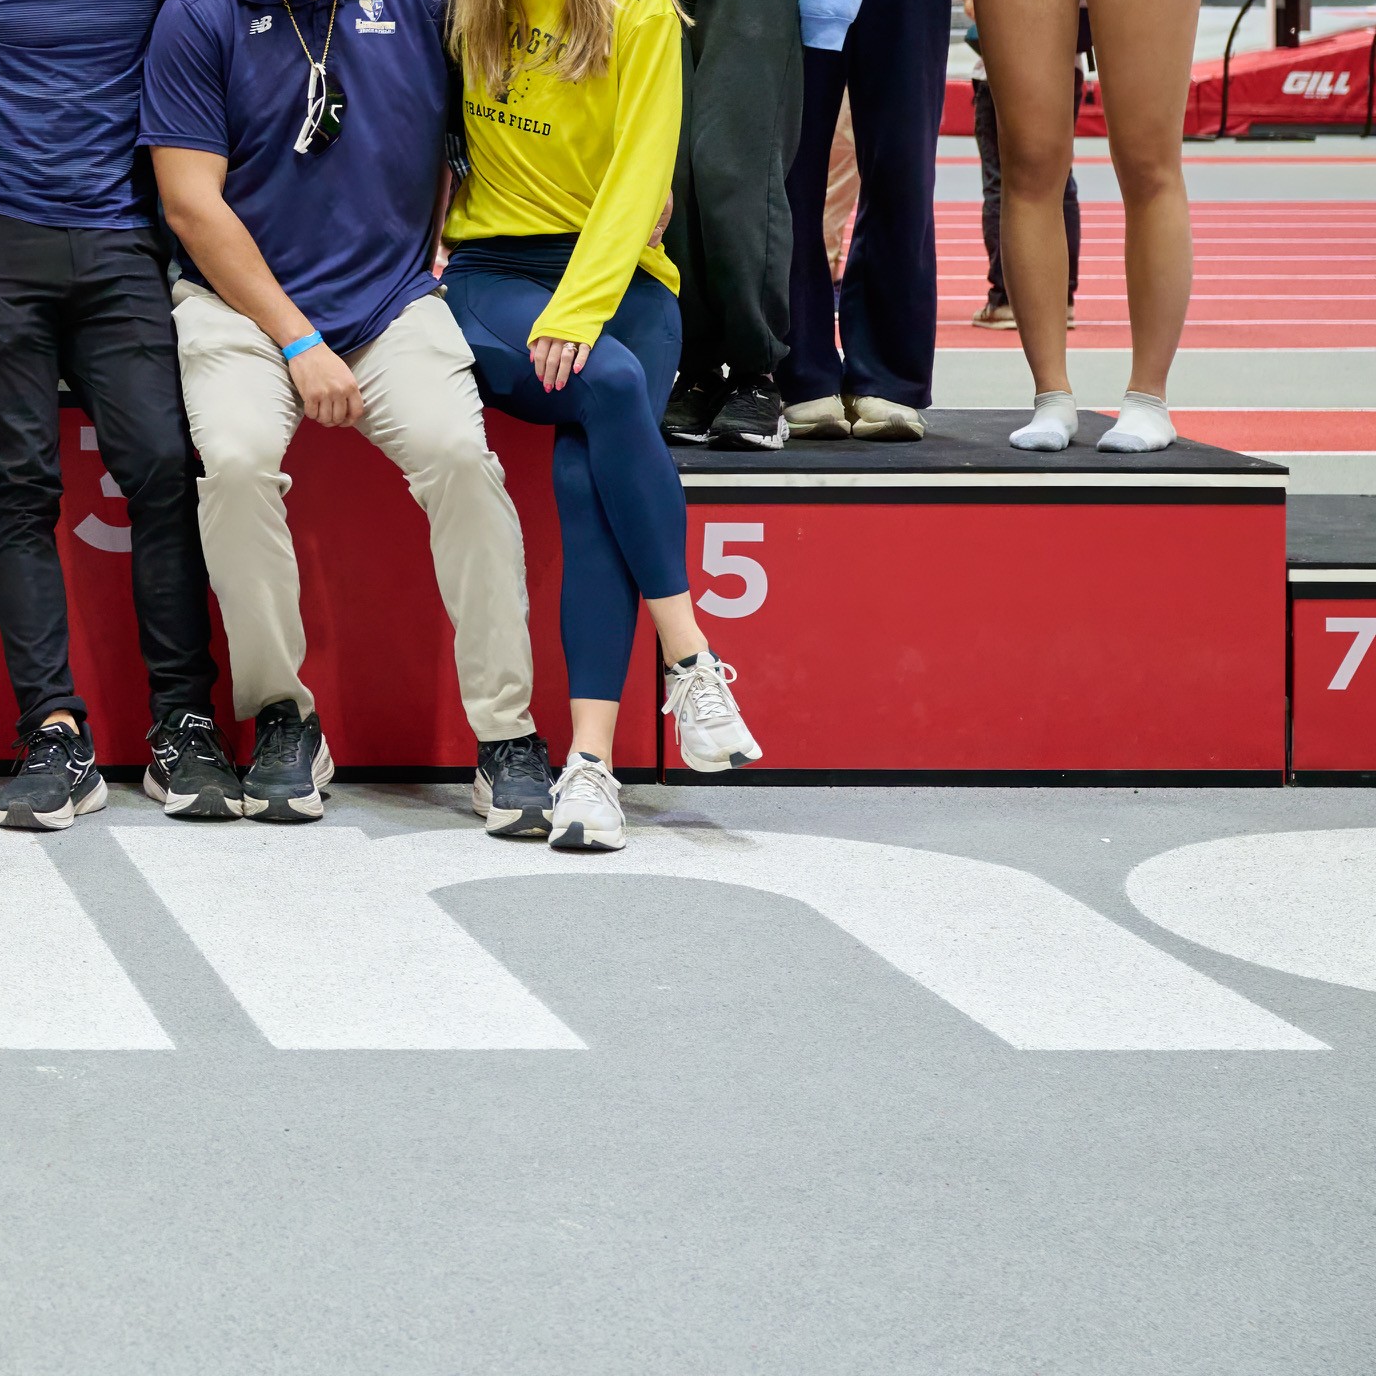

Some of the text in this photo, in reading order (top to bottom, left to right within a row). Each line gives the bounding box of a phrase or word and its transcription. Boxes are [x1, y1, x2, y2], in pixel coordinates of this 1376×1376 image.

[1282, 71, 1351, 96] GILL
[497, 111, 505, 123] &
[509, 114, 551, 136] FIELD
[696, 522, 768, 619] 5
[1325, 617, 1376, 691] 7
